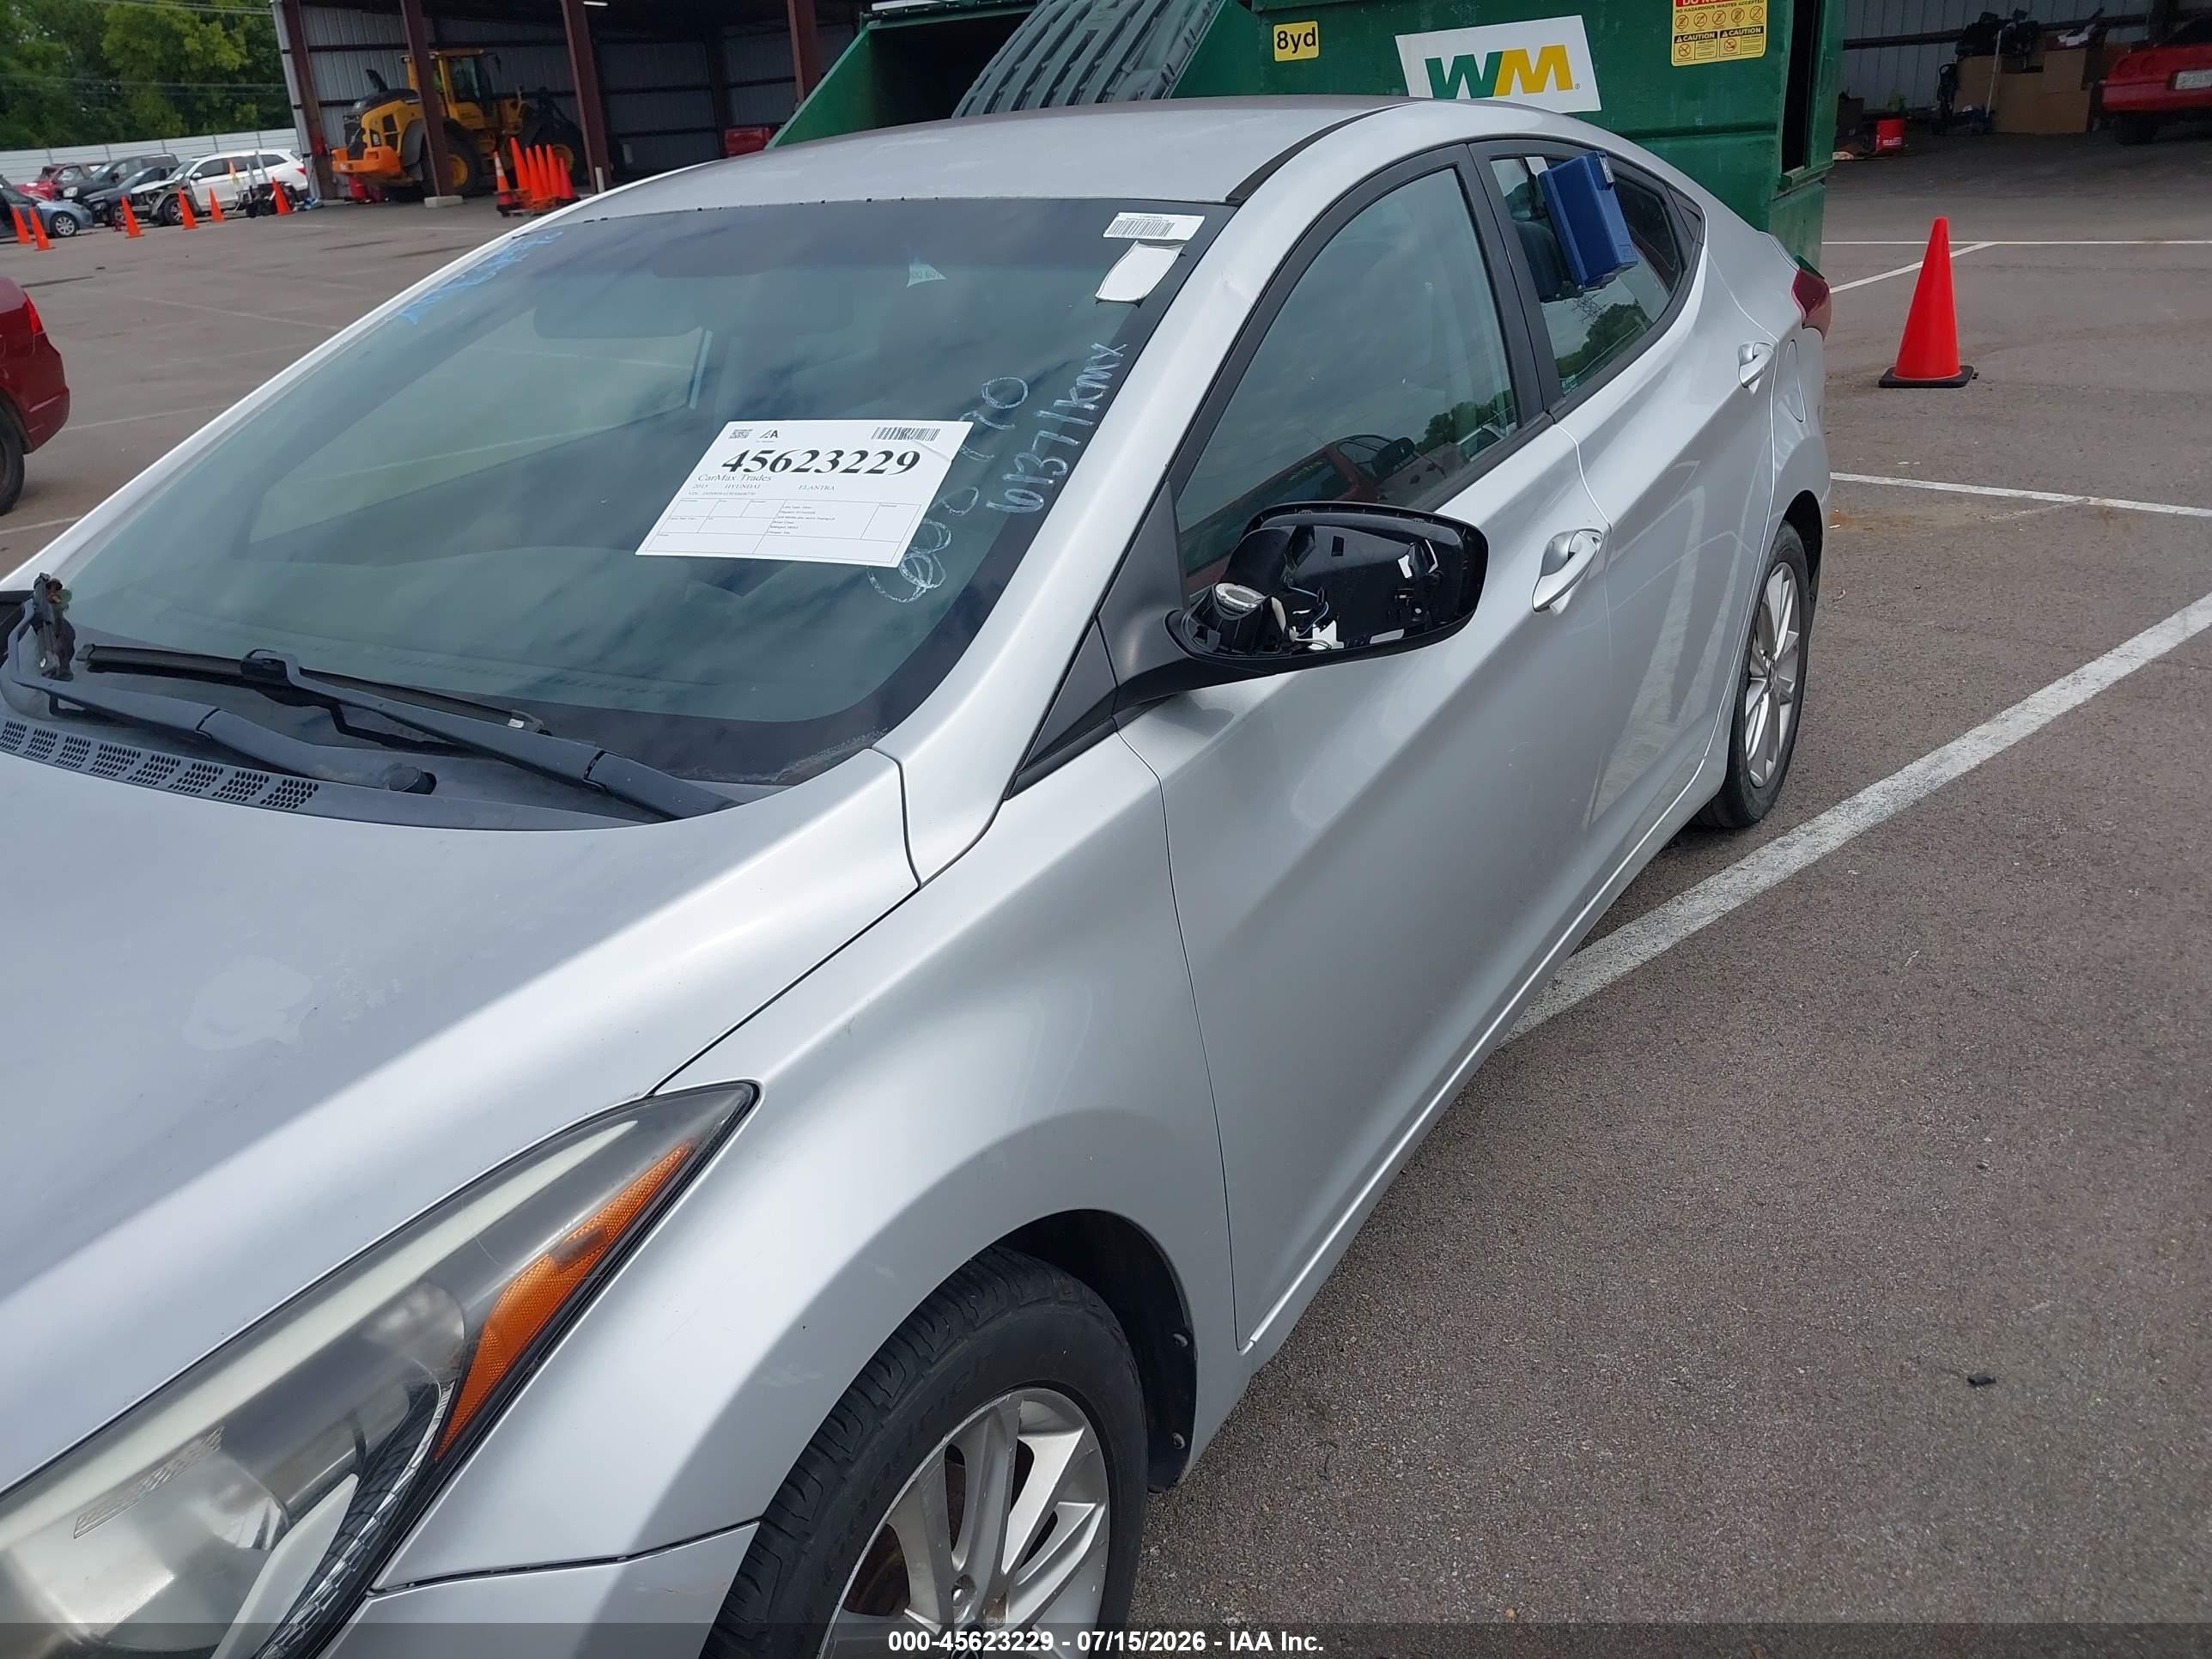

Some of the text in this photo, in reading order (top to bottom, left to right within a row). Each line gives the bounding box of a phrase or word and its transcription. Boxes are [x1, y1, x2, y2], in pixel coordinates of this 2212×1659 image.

[1276, 27, 1316, 54] 8yd
[1683, 32, 1716, 42] CAUTION
[1729, 27, 1761, 36] CAUTION
[1425, 45, 1573, 100] WM
[721, 449, 921, 476] 45623229
[697, 473, 737, 482] CarMax
